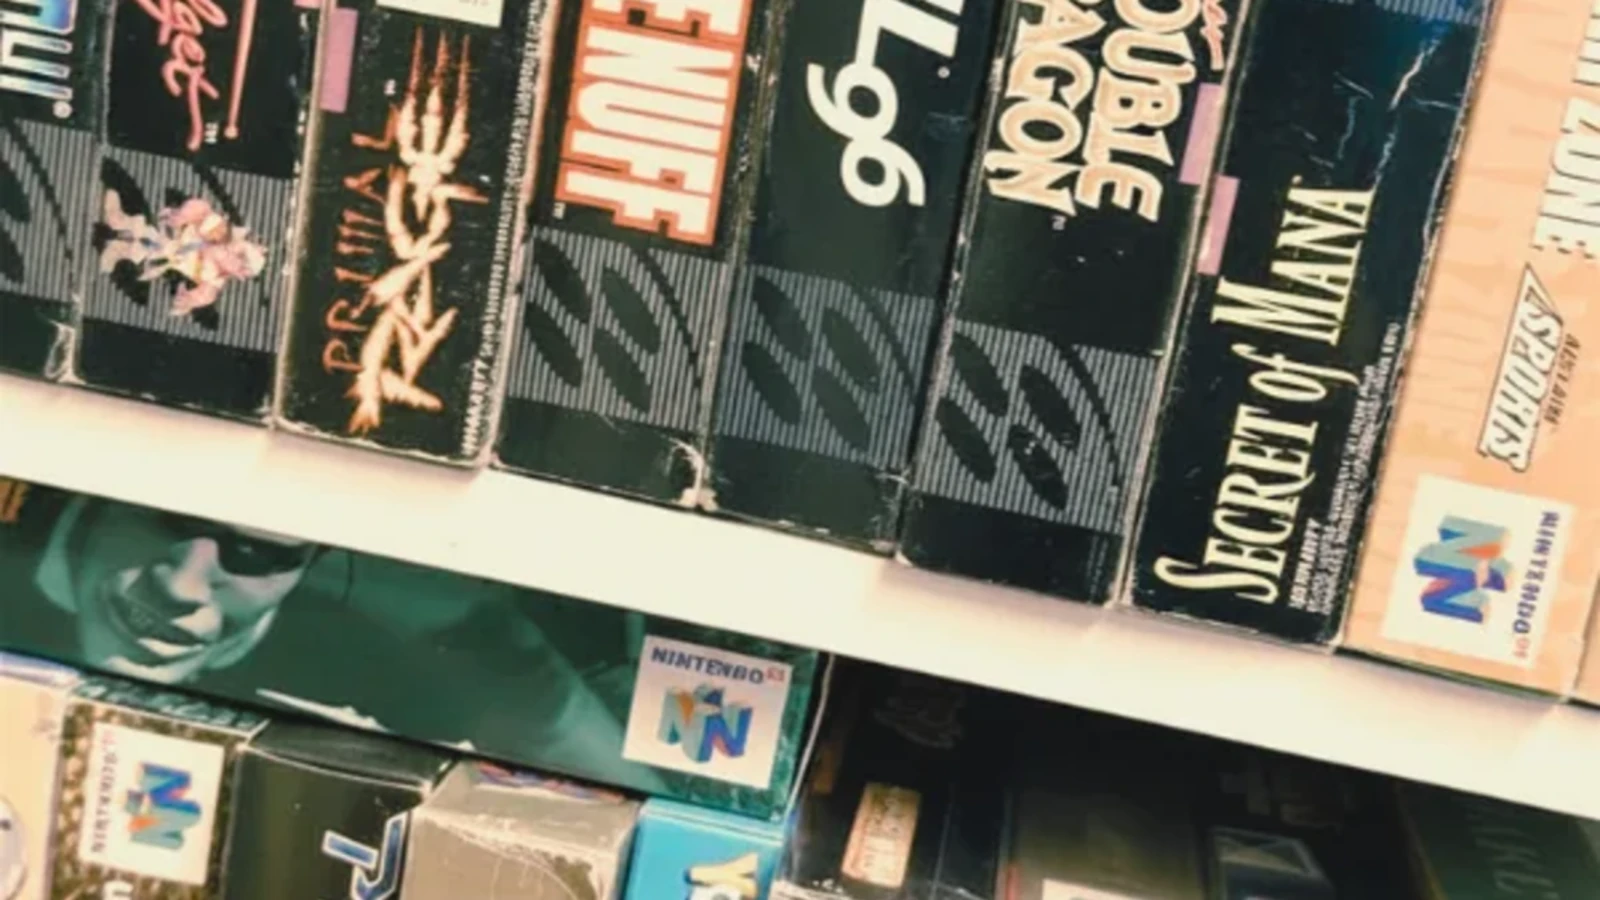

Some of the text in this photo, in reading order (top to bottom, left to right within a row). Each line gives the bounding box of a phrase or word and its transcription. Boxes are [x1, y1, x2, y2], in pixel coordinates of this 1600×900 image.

[983, 0, 1107, 217] AGON
[1210, 185, 1377, 347] MANA
[1230, 342, 1360, 402] of
[1153, 402, 1319, 605] SECRET
[1511, 509, 1561, 635] NINTENDO
[651, 645, 764, 685] NINTENDO
